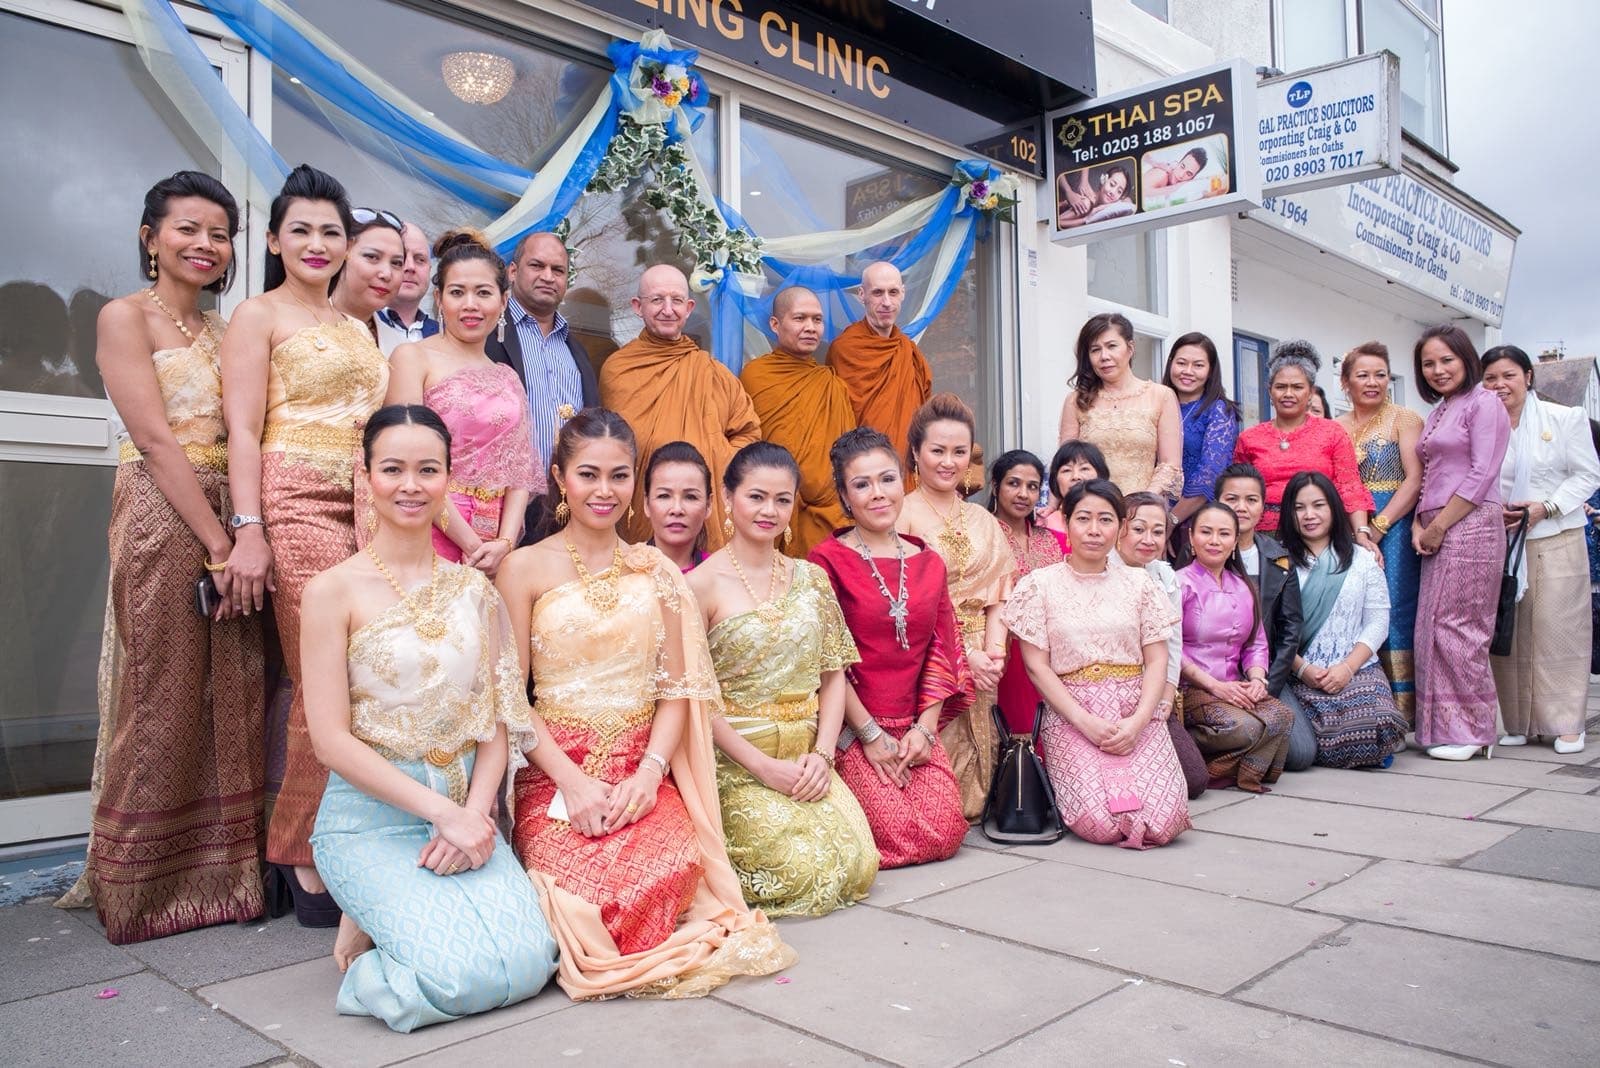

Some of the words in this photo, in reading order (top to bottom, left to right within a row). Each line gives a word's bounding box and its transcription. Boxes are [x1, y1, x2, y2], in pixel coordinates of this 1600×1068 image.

[635, 0, 744, 40] NG
[759, 10, 890, 99] CLINIC
[1088, 100, 1156, 136] THAI
[1164, 83, 1224, 116] SPA
[1277, 107, 1319, 131] PRACTICE
[1321, 94, 1374, 121] SOLICITORS
[1288, 89, 1311, 102] TLP
[1010, 135, 1037, 164] 102
[1072, 145, 1099, 163] Tel:
[1102, 134, 1140, 157] 0203
[1143, 125, 1172, 146] 188
[1176, 113, 1215, 138] 1067
[1259, 130, 1305, 153] orporating
[1307, 123, 1332, 141] Craig
[1333, 120, 1342, 135] &
[1344, 118, 1357, 133] Co
[1259, 149, 1308, 165] ommisioners
[1309, 144, 1320, 156] for
[1322, 140, 1344, 154] Oaths
[1266, 165, 1290, 183] 020
[1293, 158, 1326, 178] 8903
[1330, 150, 1364, 171] 7017
[1262, 197, 1277, 213] st
[1280, 199, 1308, 226] 1964
[1347, 184, 1415, 246] Incorporating
[1417, 223, 1440, 258] Craig
[1440, 237, 1448, 259] &
[1449, 242, 1460, 264] Co
[1383, 175, 1439, 225] PRACTICE
[1438, 201, 1493, 257] SOLICITORS
[1356, 221, 1414, 264] Commisioners
[1414, 251, 1426, 270] for
[1427, 257, 1448, 281] Oaths
